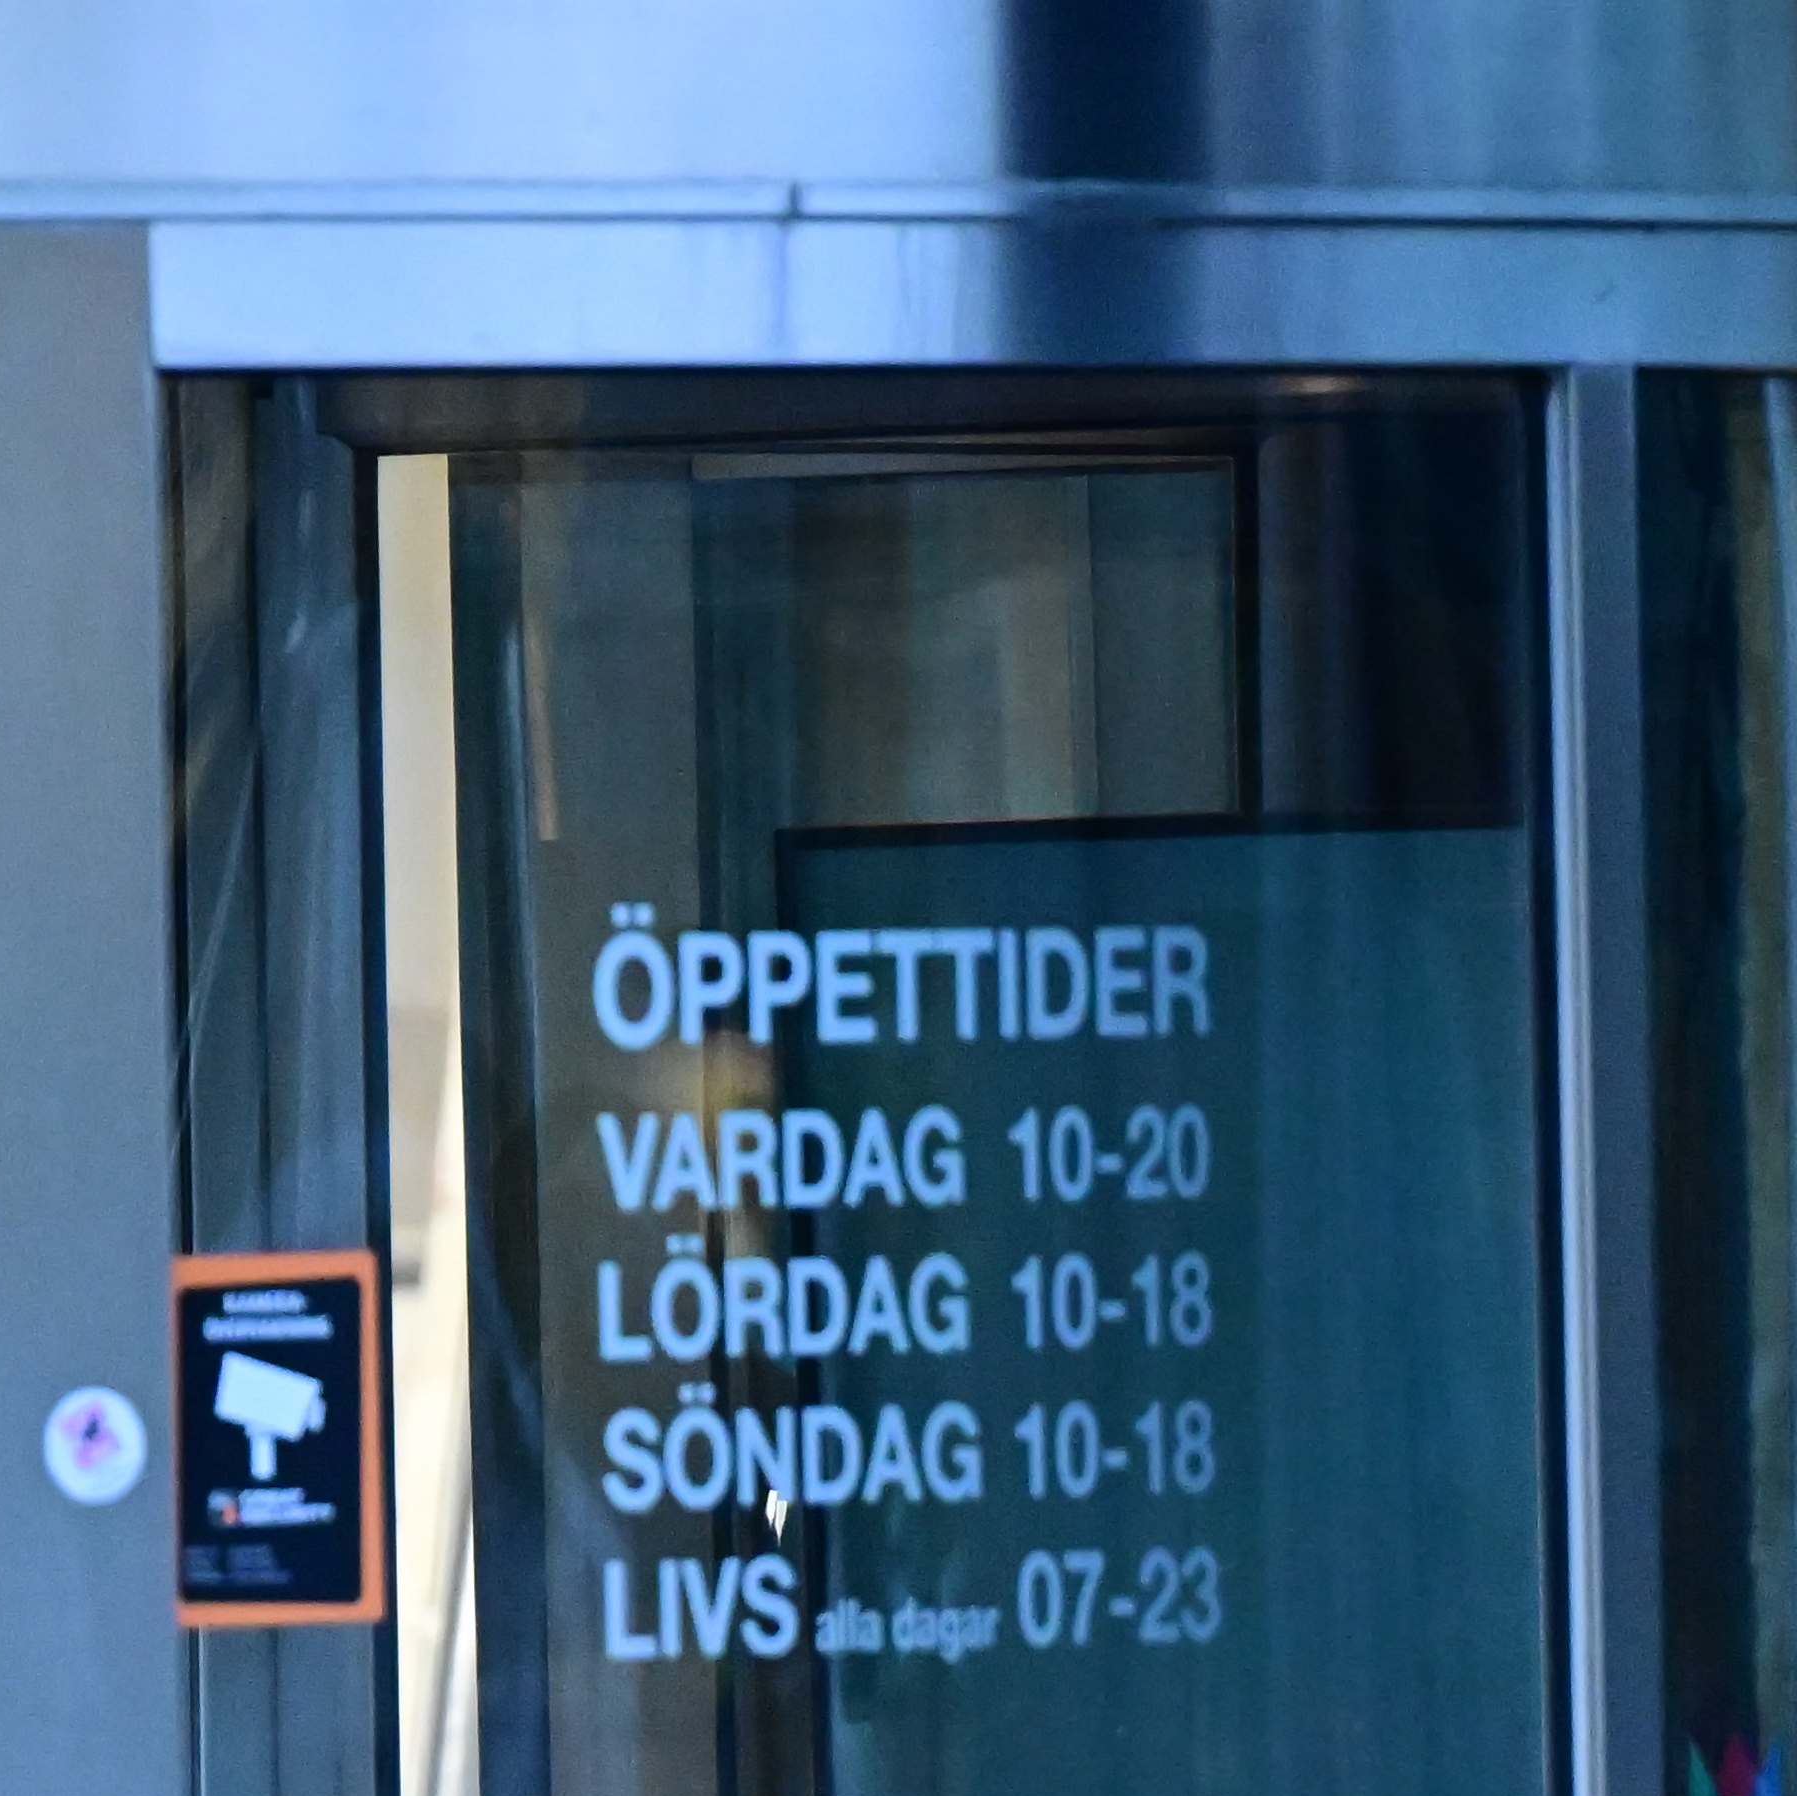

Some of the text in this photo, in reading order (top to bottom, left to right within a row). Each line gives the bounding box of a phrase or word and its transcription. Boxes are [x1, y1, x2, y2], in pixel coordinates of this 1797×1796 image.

[593, 901, 1209, 1049] ÖPPETTIDER
[598, 1104, 1208, 1211] VARDAG 10-20
[598, 1234, 1212, 1360] LÖRDAG 10-18
[603, 1382, 1216, 1512] SÖNDAG 10-18
[605, 1546, 1223, 1665] LIVS alla dagar 07-23
